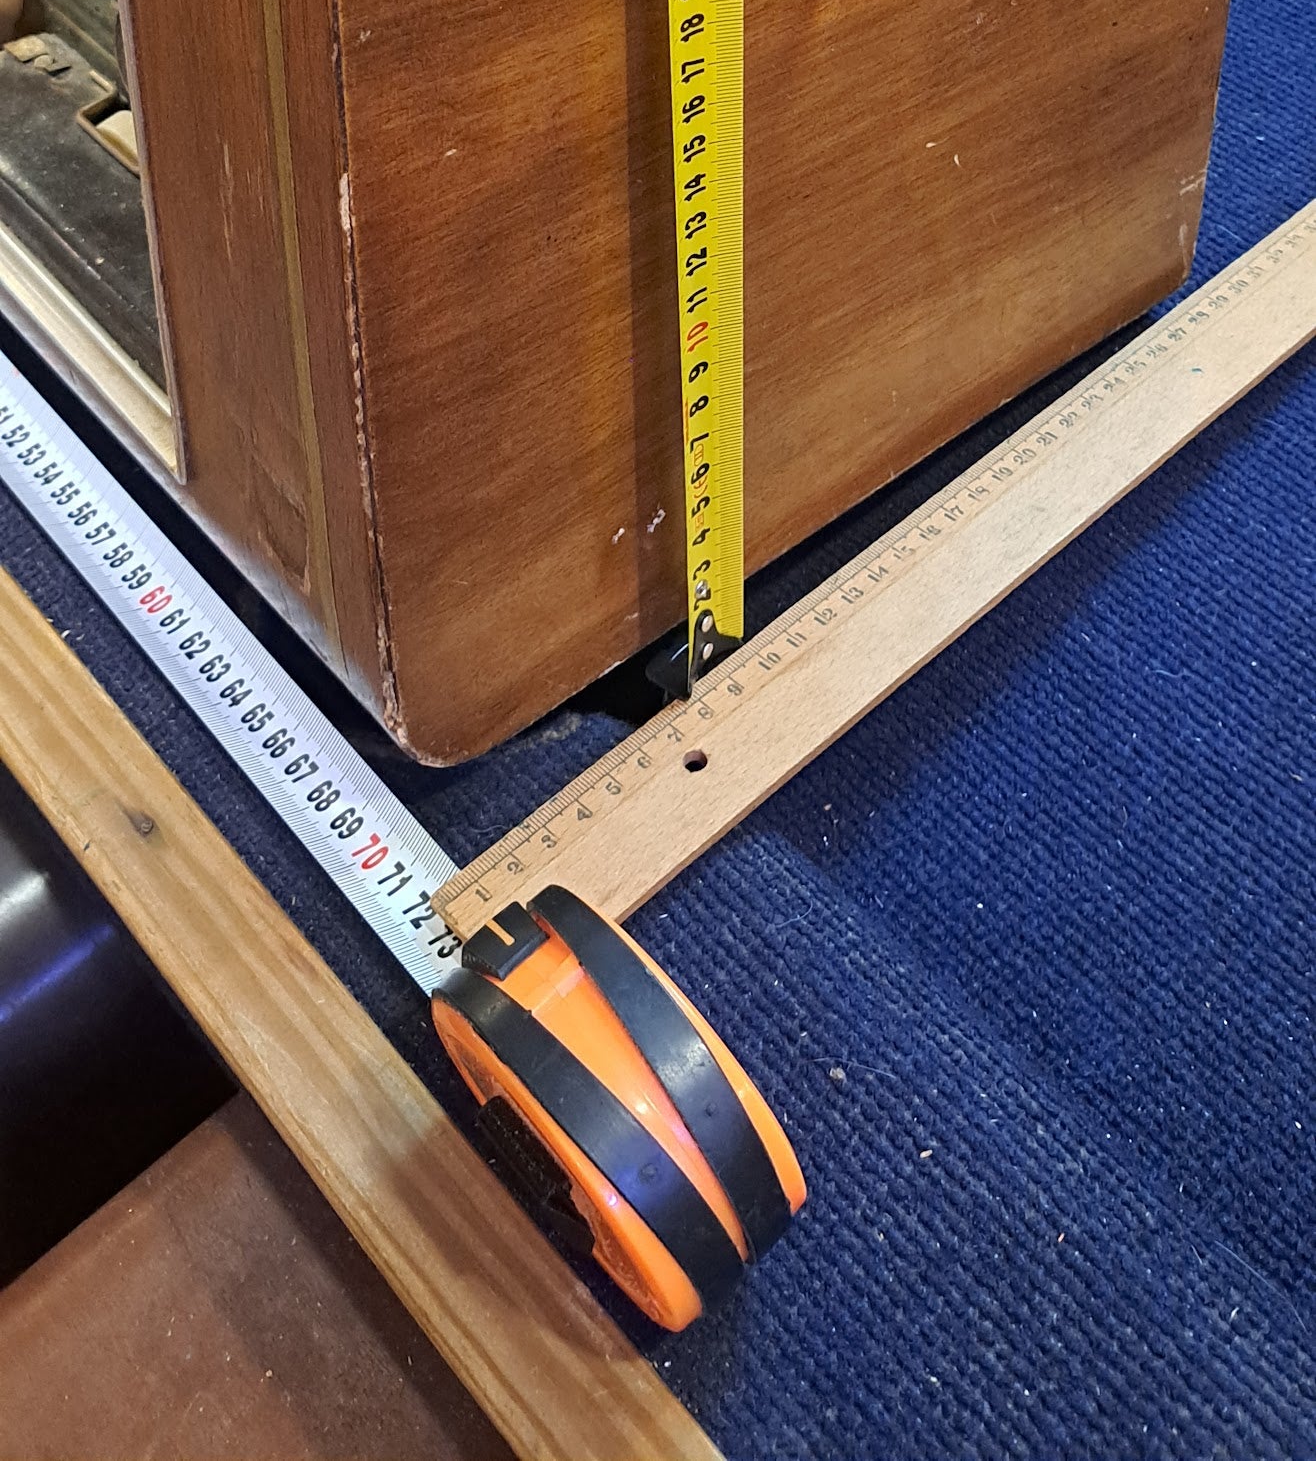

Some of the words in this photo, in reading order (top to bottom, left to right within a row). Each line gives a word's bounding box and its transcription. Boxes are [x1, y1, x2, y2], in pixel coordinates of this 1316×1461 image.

[679, 13, 705, 43] 18
[680, 57, 705, 85] 17
[681, 94, 706, 125] 16
[682, 134, 707, 164] 15
[683, 172, 707, 202] 14
[684, 211, 707, 240] 13
[685, 246, 708, 277] 12
[685, 286, 708, 314] 11
[686, 321, 709, 353] 10
[688, 360, 709, 384] 9
[688, 394, 710, 418] 8
[689, 432, 710, 454] 7
[691, 462, 711, 485] 6
[691, 495, 711, 519] 5
[691, 526, 711, 547] 4
[692, 559, 712, 581] 3
[475, 889, 493, 902] 1
[507, 861, 524, 875] 2
[541, 835, 557, 848] 3
[577, 808, 593, 821] 4
[605, 781, 621, 795] 5
[637, 756, 651, 768] 6
[667, 729, 682, 742] 7
[698, 706, 713, 719] 8
[727, 683, 743, 696] 9
[758, 652, 781, 670] 10
[786, 632, 807, 647] 11
[814, 608, 837, 625] 12
[841, 587, 864, 604] 13
[868, 566, 889, 582] 14
[893, 545, 916, 559] 15
[919, 525, 941, 540] 16
[944, 505, 964, 521] 17
[968, 486, 990, 501] 18
[992, 467, 1013, 481] 19
[1013, 448, 1037, 465] 20
[1036, 432, 1058, 446] 21
[0, 424, 31, 449] 52
[16, 442, 47, 467] 53
[32, 461, 64, 487] 54
[49, 481, 81, 506] 55
[67, 500, 98, 527] 56
[86, 521, 117, 546] 57
[103, 541, 135, 569] 58
[120, 563, 153, 591] 59
[138, 585, 173, 614] 60
[158, 608, 192, 636] 61
[178, 630, 212, 661] 62
[198, 653, 232, 683] 63
[218, 677, 254, 709] 64
[239, 702, 276, 733] 65
[261, 727, 296, 759] 66
[283, 753, 320, 784] 67
[306, 779, 342, 812] 68
[329, 806, 365, 840] 69
[351, 832, 390, 870] 70
[376, 860, 414, 897] 71
[402, 890, 437, 930] 72
[428, 924, 463, 958] 73
